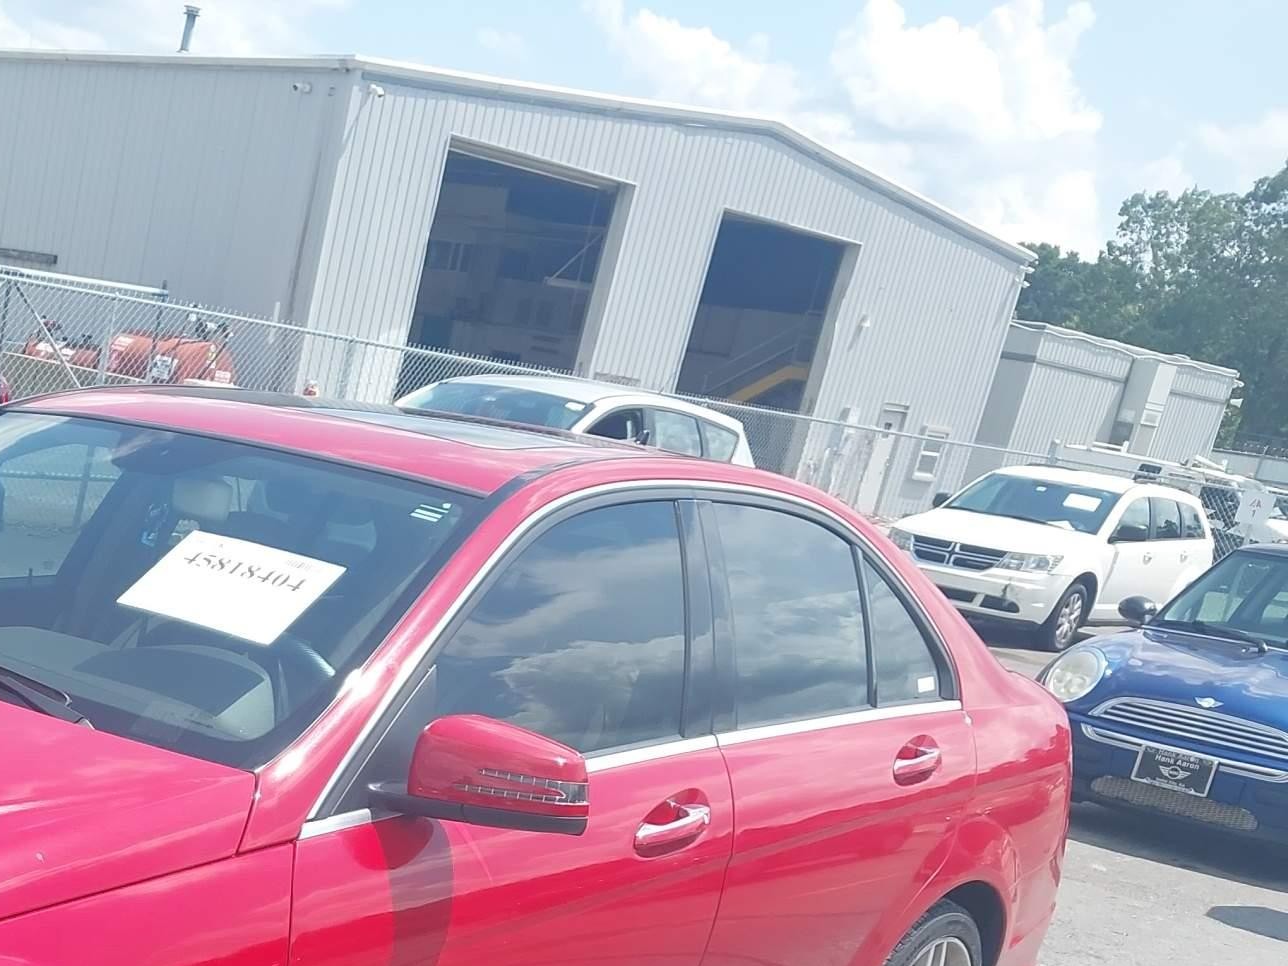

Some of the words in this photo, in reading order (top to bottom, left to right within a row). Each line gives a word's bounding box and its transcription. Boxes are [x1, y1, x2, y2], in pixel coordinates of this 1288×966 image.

[184, 552, 307, 592] 45818404
[1155, 755, 1174, 765] Hank
[1176, 759, 1200, 770] Aaron
